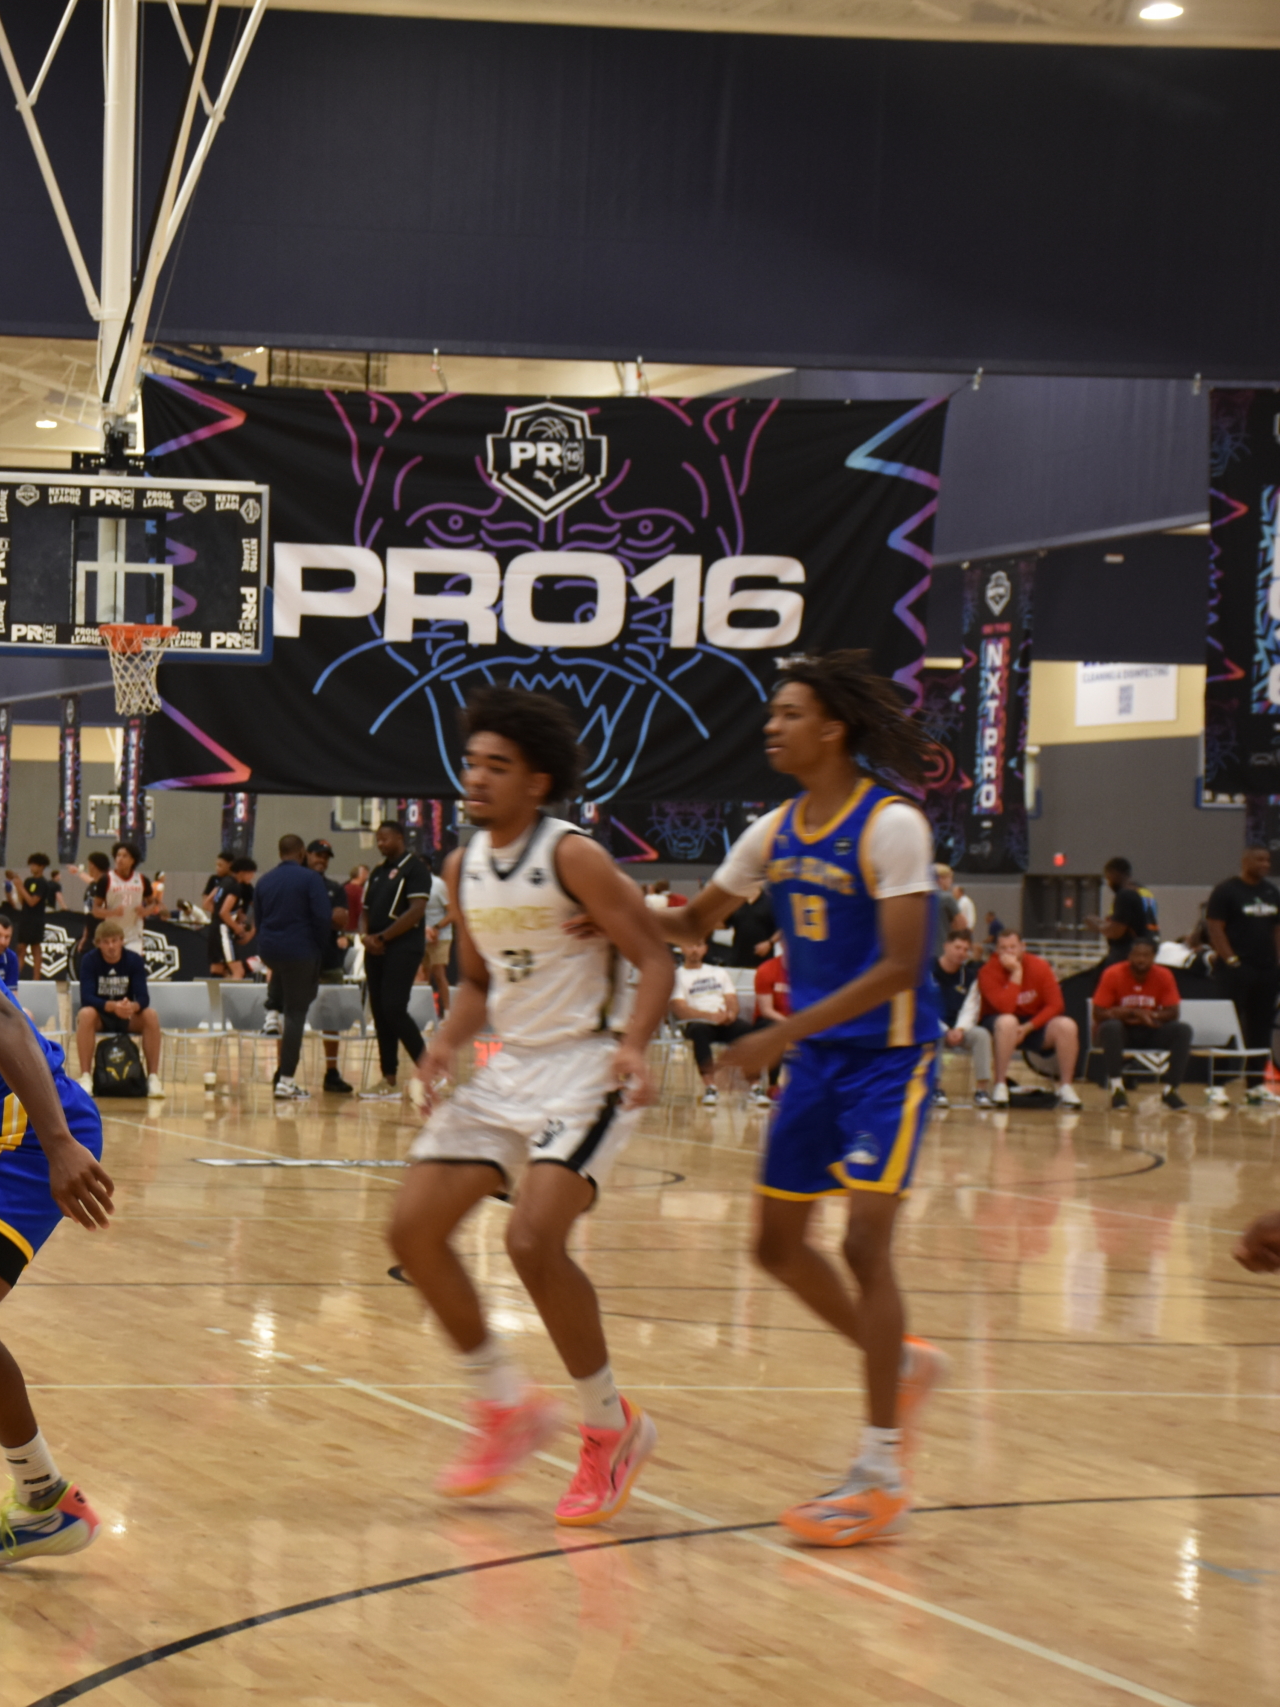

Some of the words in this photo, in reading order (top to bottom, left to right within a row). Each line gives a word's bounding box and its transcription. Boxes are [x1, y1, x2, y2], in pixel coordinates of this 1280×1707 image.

[48, 487, 81, 496] NXTPRO
[146, 490, 171, 500] PRO16
[49, 496, 81, 506] LEAGUE
[143, 499, 175, 509] LEAGUE
[273, 542, 806, 650] PRO16
[979, 643, 1003, 808] NXTPRO
